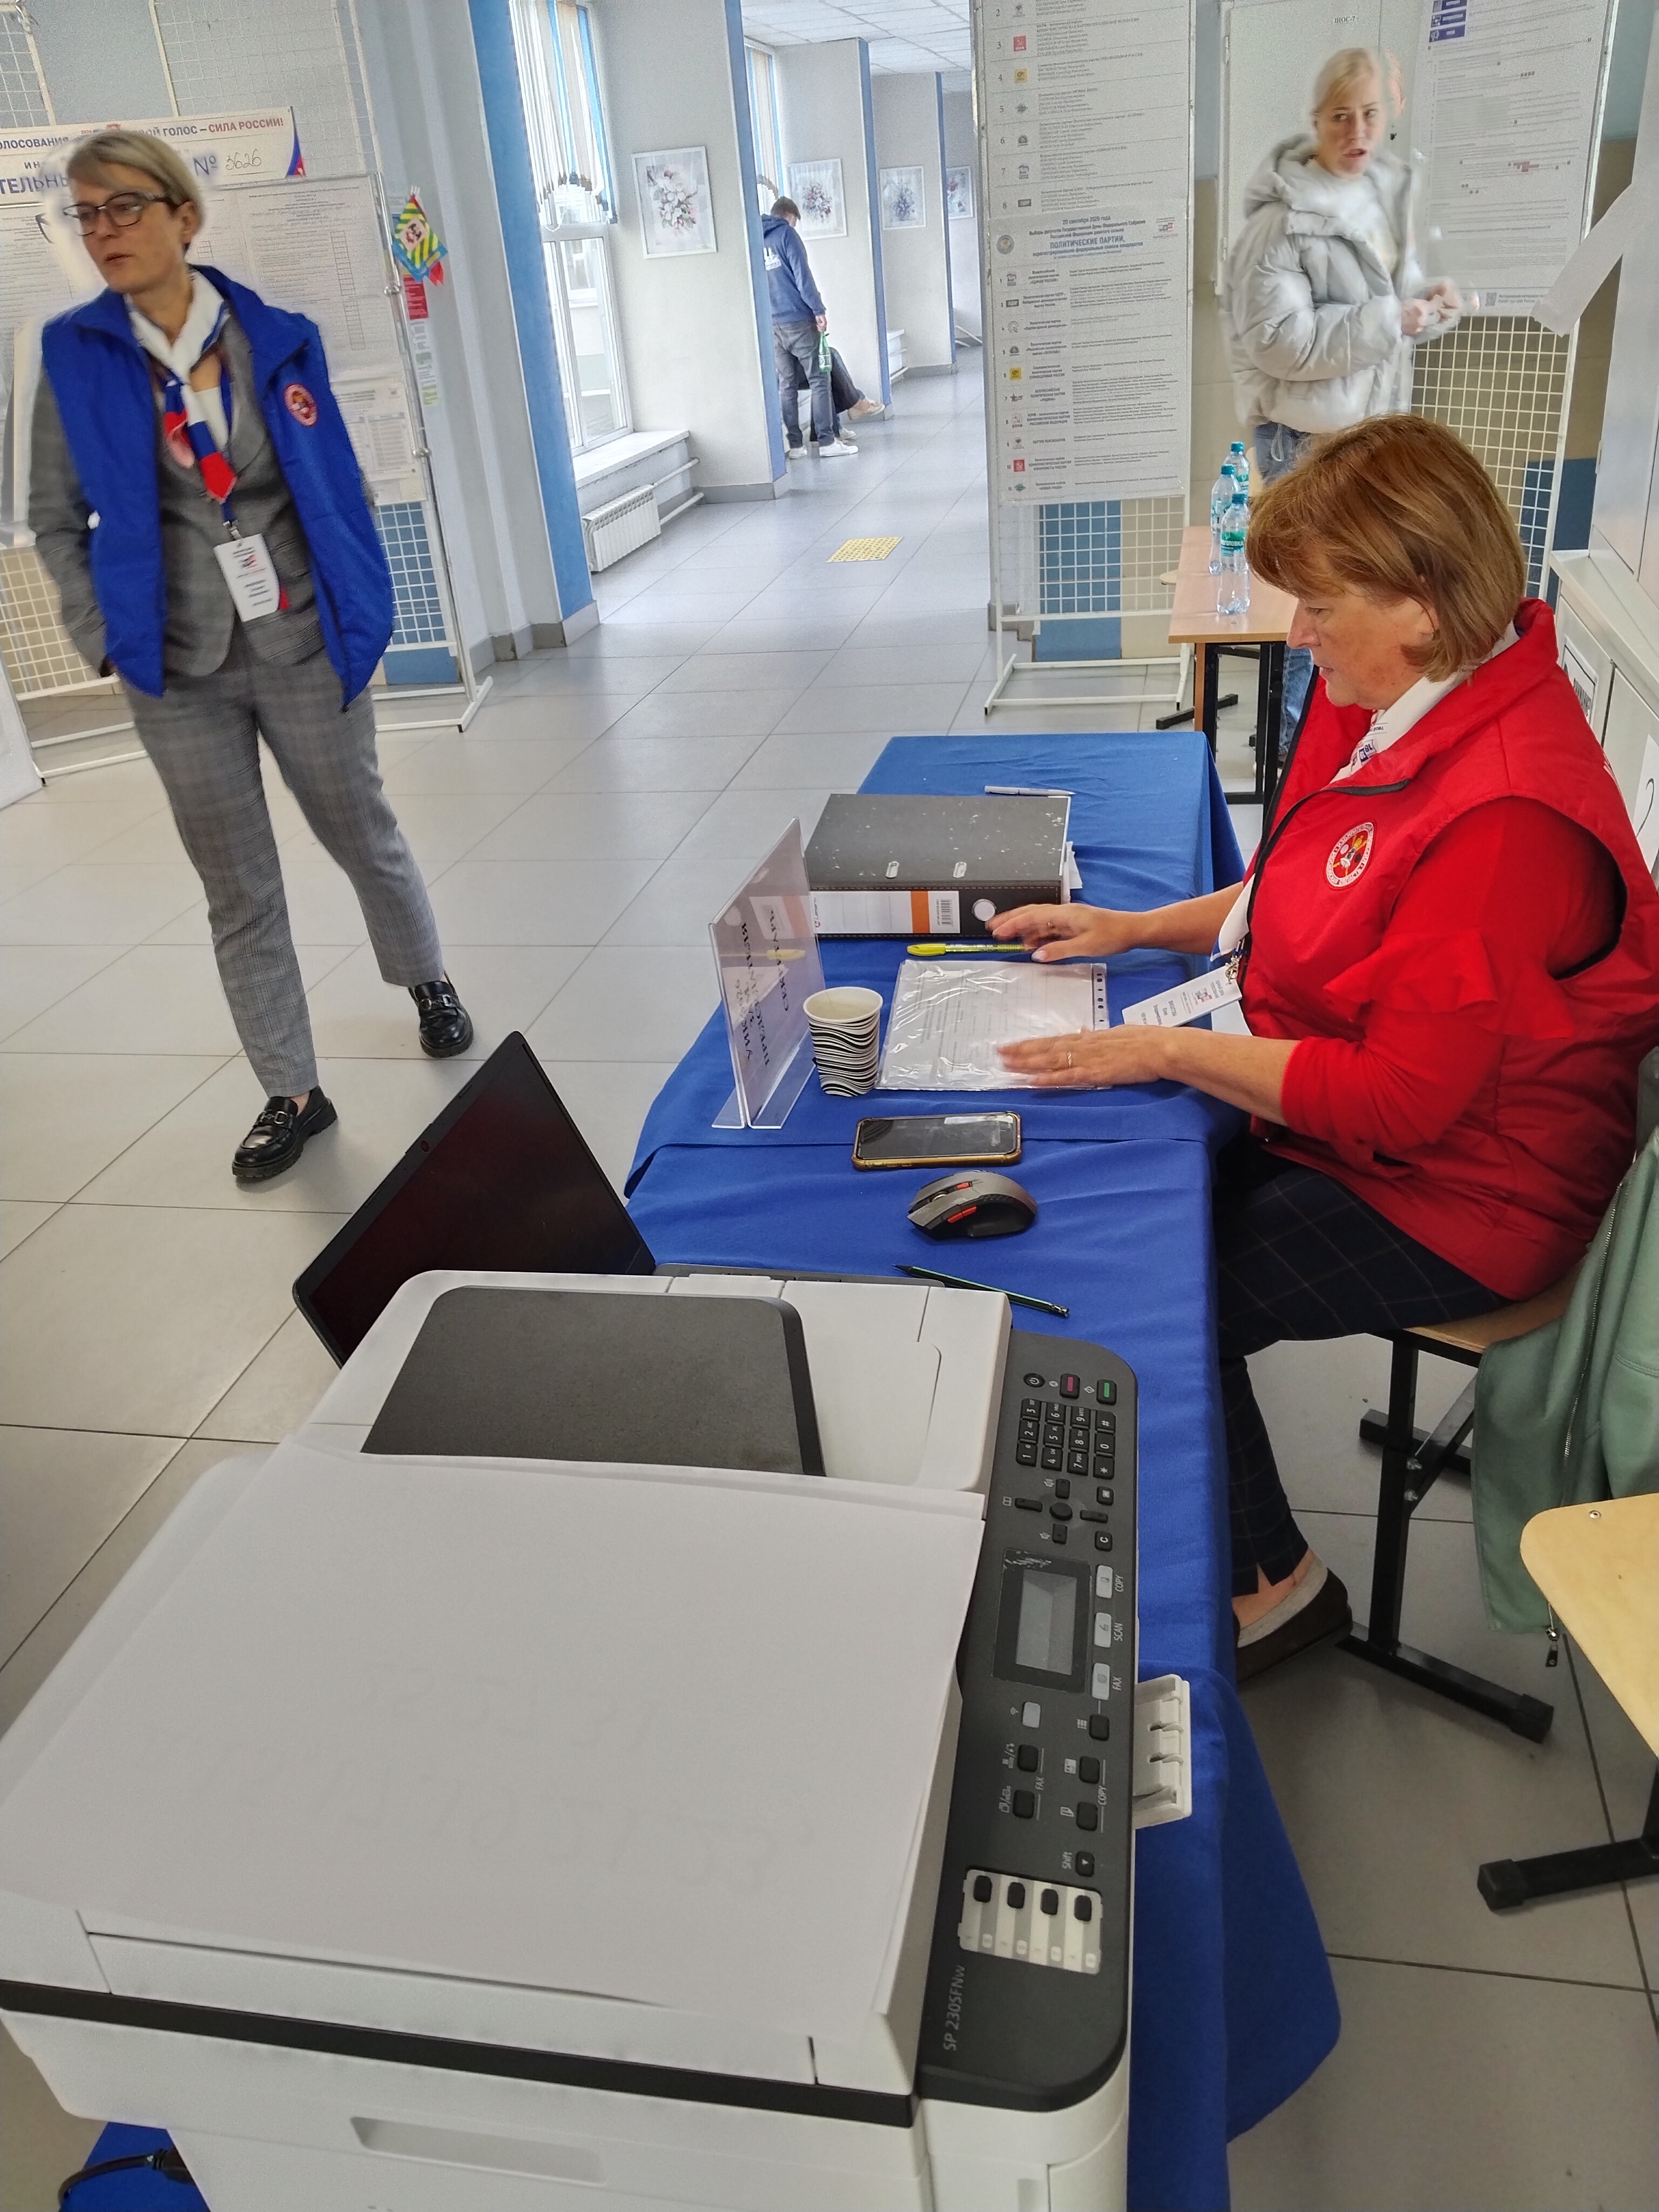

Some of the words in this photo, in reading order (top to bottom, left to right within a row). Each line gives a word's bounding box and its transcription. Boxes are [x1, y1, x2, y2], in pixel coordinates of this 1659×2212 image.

[163, 125, 198, 136] ГОЛОС
[208, 121, 237, 133] СИЛА
[239, 117, 284, 130] РОССИИ!
[225, 149, 262, 171] 3626
[1050, 238, 1098, 249] ПОЛИТИЧЕСКИЕ
[1100, 235, 1125, 244] ПАРТИИ,
[1364, 744, 1373, 752] 18
[1115, 1574, 1124, 1593] COPY
[1114, 1622, 1123, 1642] SCAN
[1112, 1676, 1122, 1691] FAX
[1035, 1776, 1044, 1791] FAX
[1097, 1785, 1107, 1806] COPY
[1062, 1851, 1073, 1870] Shift
[946, 1964, 966, 2031] 230SFNw
[943, 2031, 957, 2052] SP
